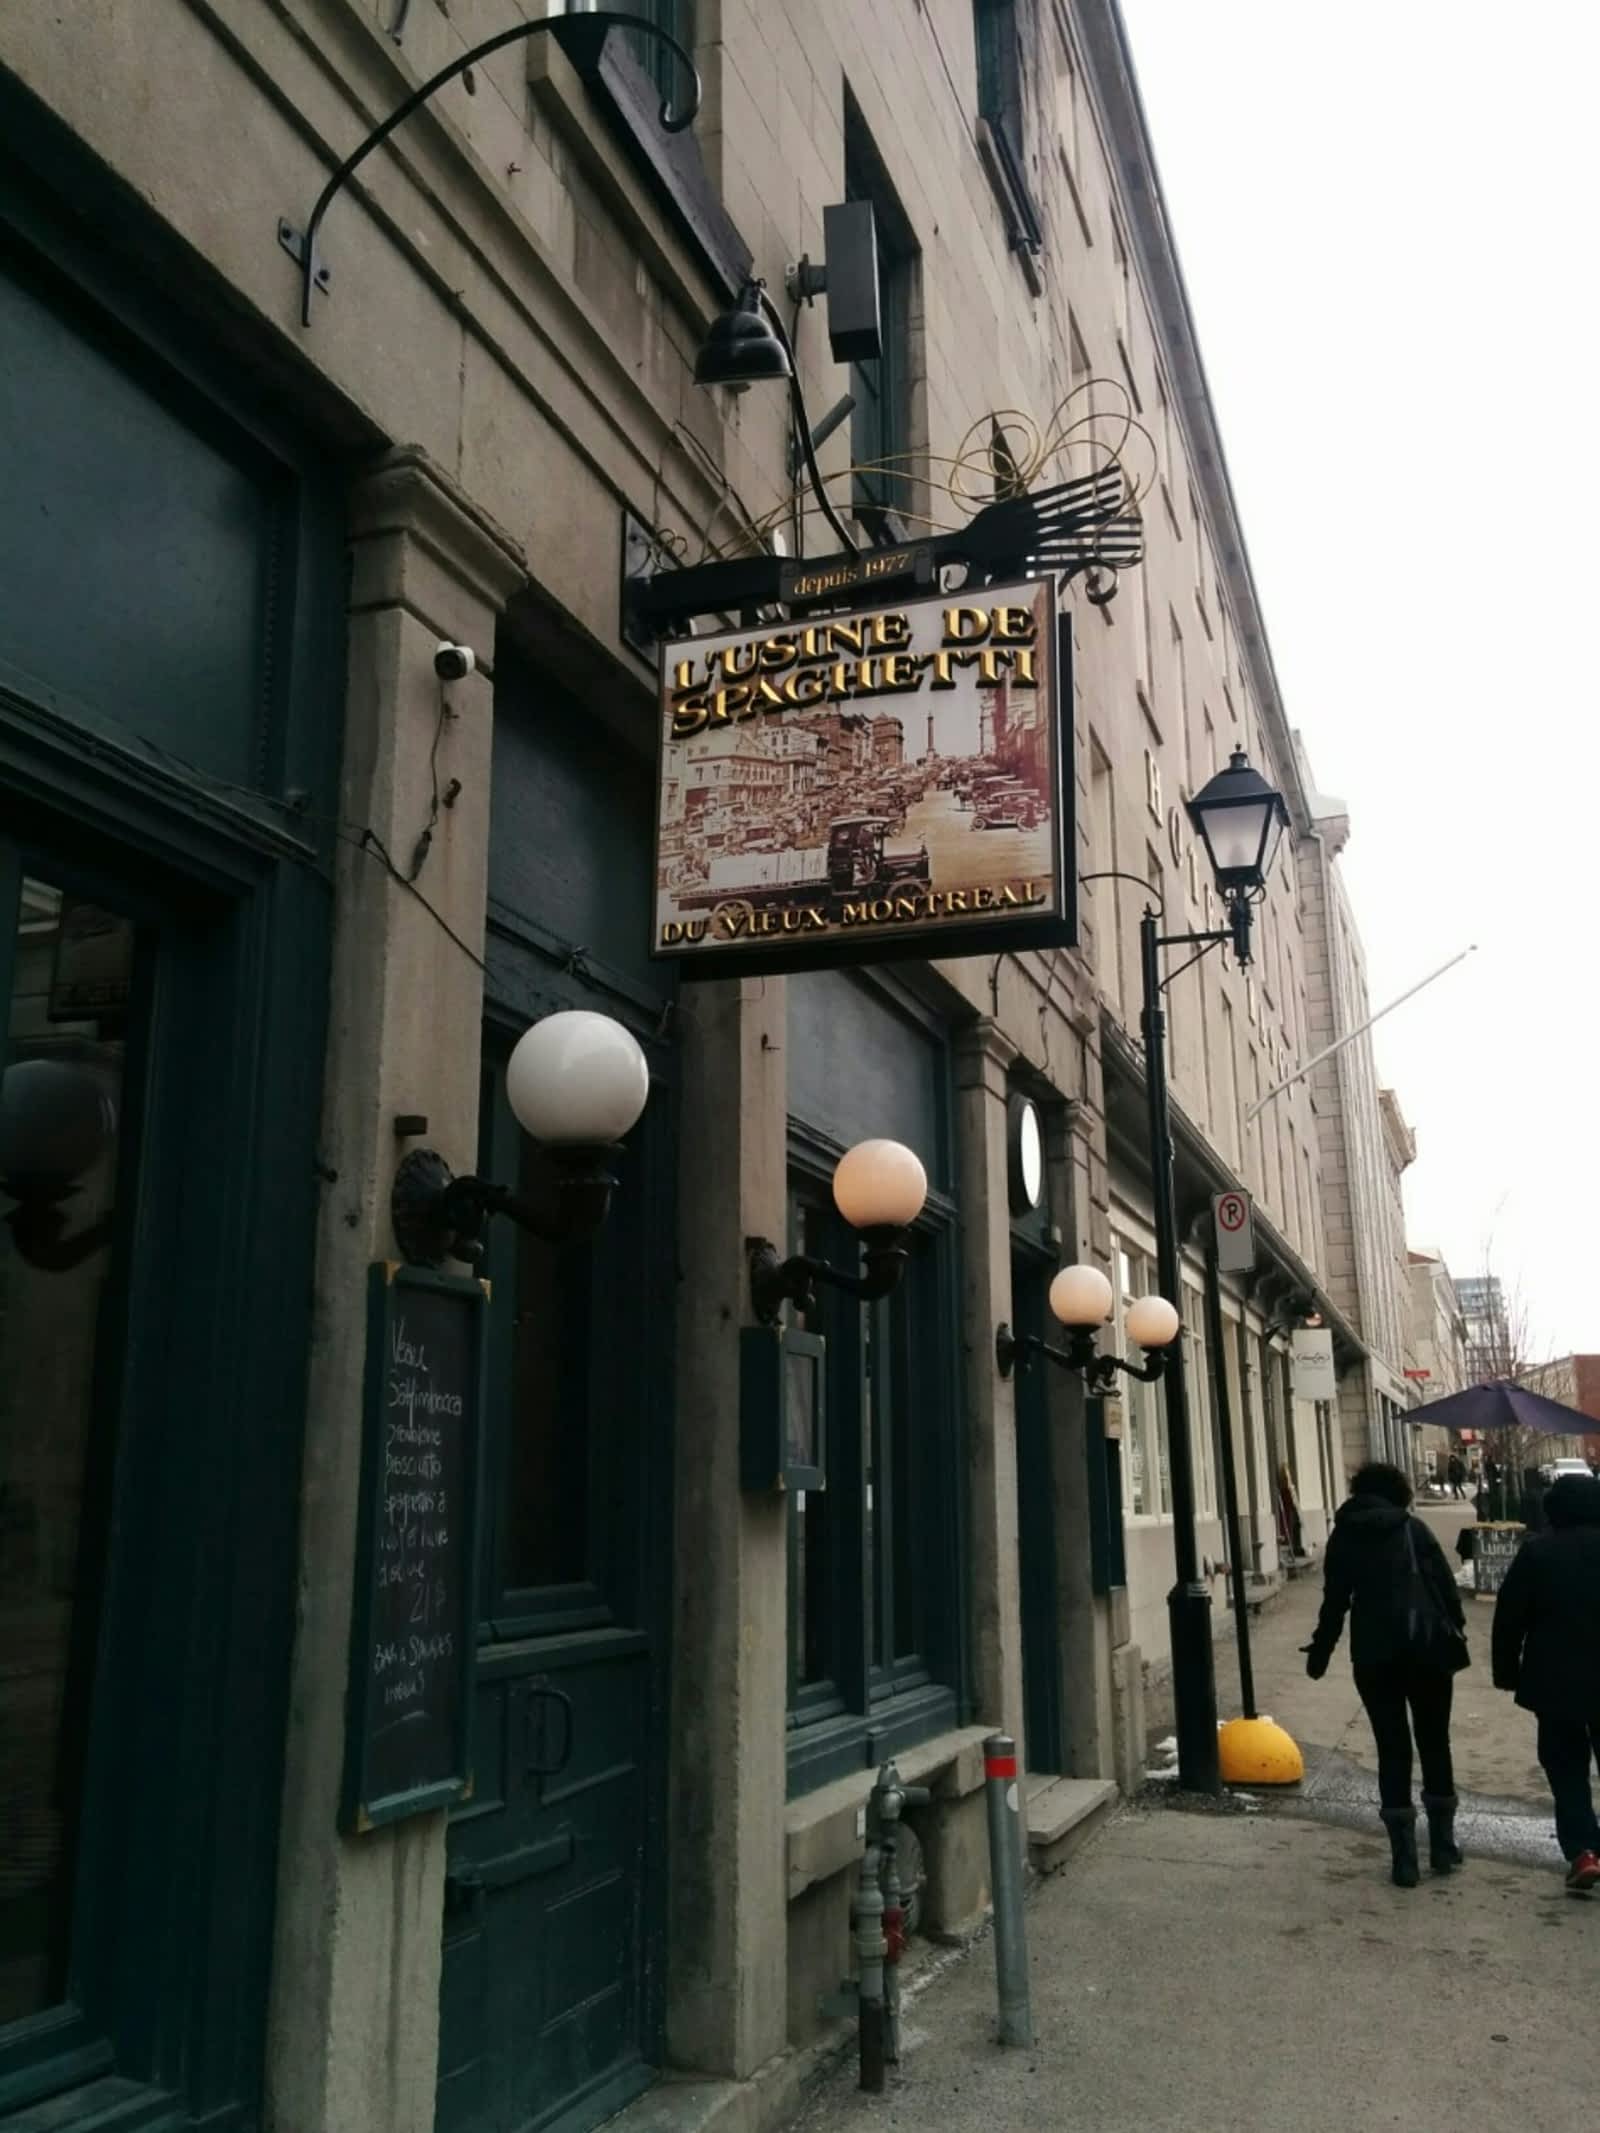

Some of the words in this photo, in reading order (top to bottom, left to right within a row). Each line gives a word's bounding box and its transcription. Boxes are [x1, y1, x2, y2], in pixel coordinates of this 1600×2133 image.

[793, 566, 857, 596] depuis
[864, 554, 908, 577] 1977
[672, 613, 911, 697] L'USINE
[942, 607, 1037, 647] DE
[671, 650, 1038, 739] SPAGHETTI
[661, 918, 707, 945] DU
[722, 907, 827, 938] VIEUX
[841, 882, 1046, 927] MONTREAL
